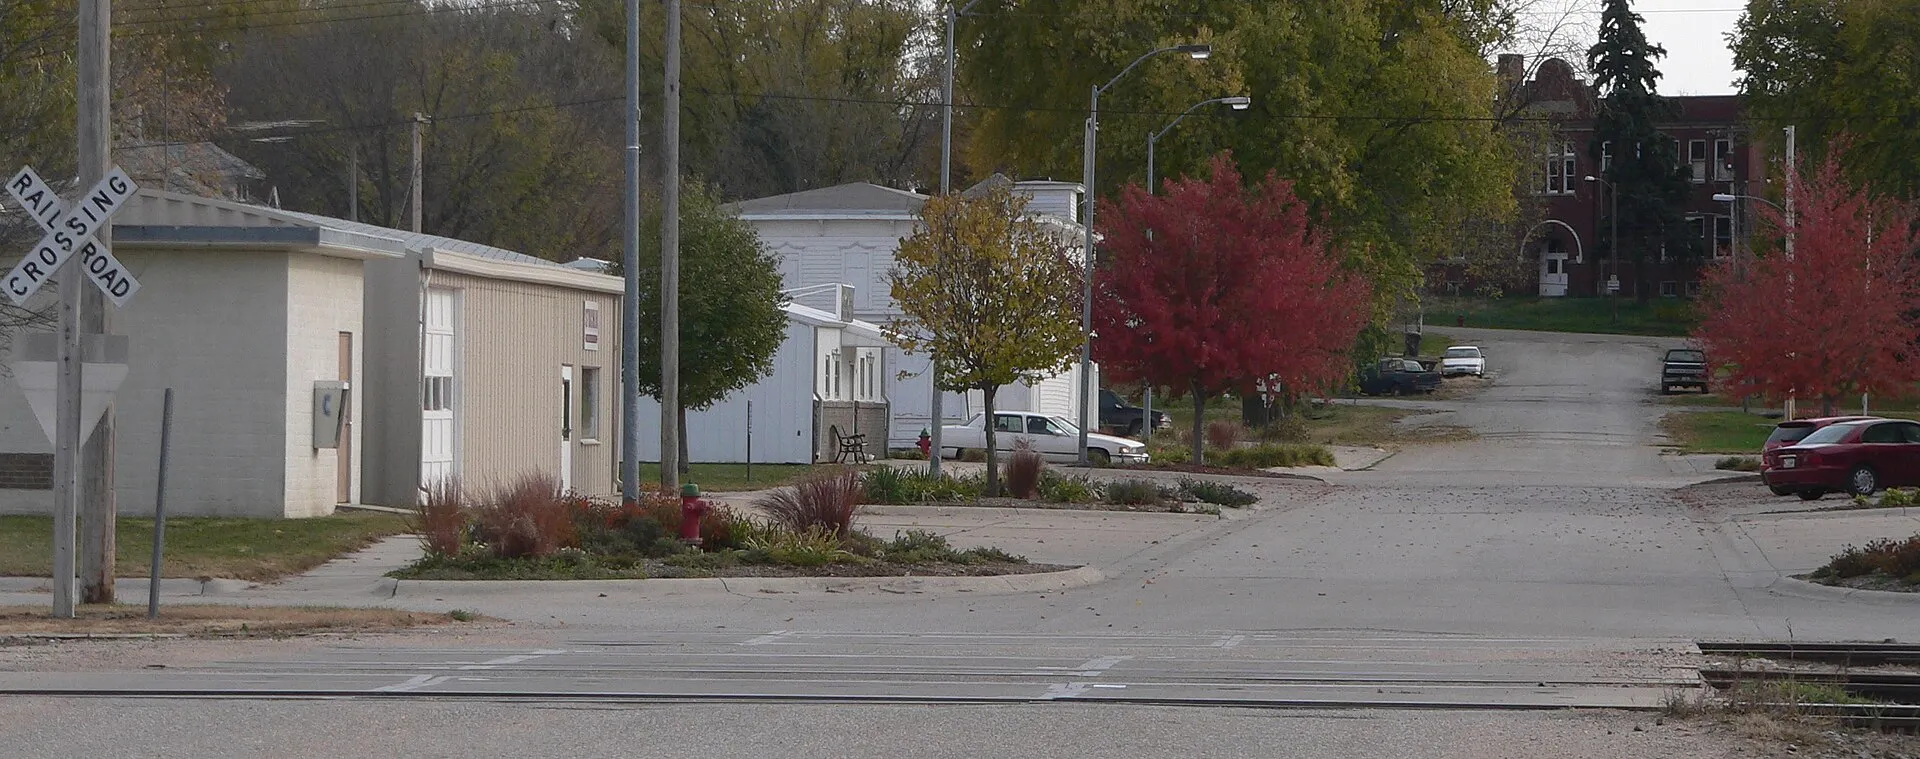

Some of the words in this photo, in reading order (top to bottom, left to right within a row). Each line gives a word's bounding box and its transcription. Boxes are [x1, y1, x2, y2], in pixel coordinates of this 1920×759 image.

[9, 176, 128, 296] CROSSING
[12, 173, 61, 230] RAIL
[81, 241, 130, 298] ROAD
